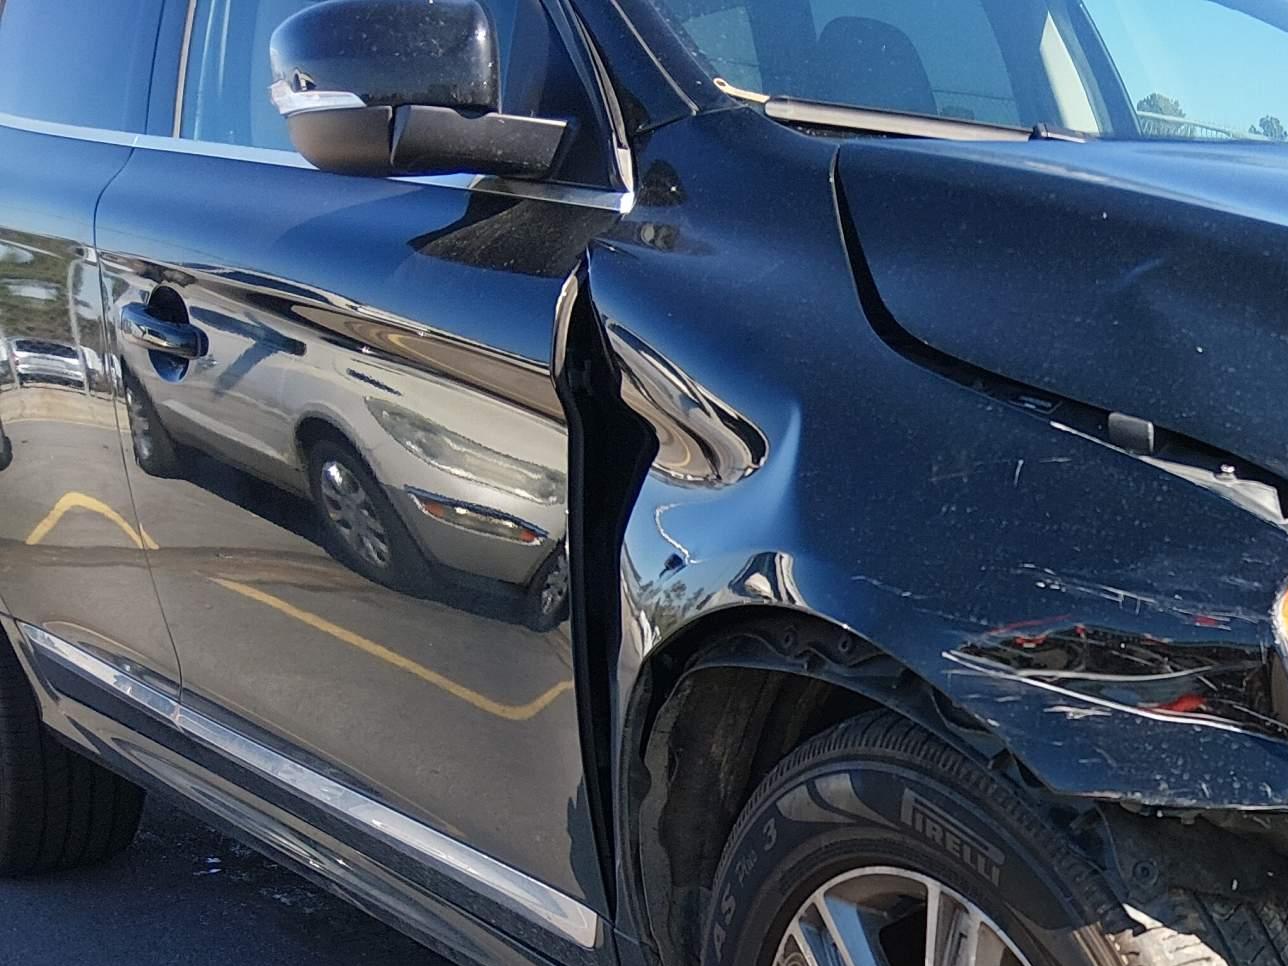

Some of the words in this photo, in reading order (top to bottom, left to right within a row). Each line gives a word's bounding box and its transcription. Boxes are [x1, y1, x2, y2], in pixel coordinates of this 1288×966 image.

[713, 883, 737, 962] AS
[762, 816, 777, 851] 3
[900, 789, 1005, 887] PIRELLI
